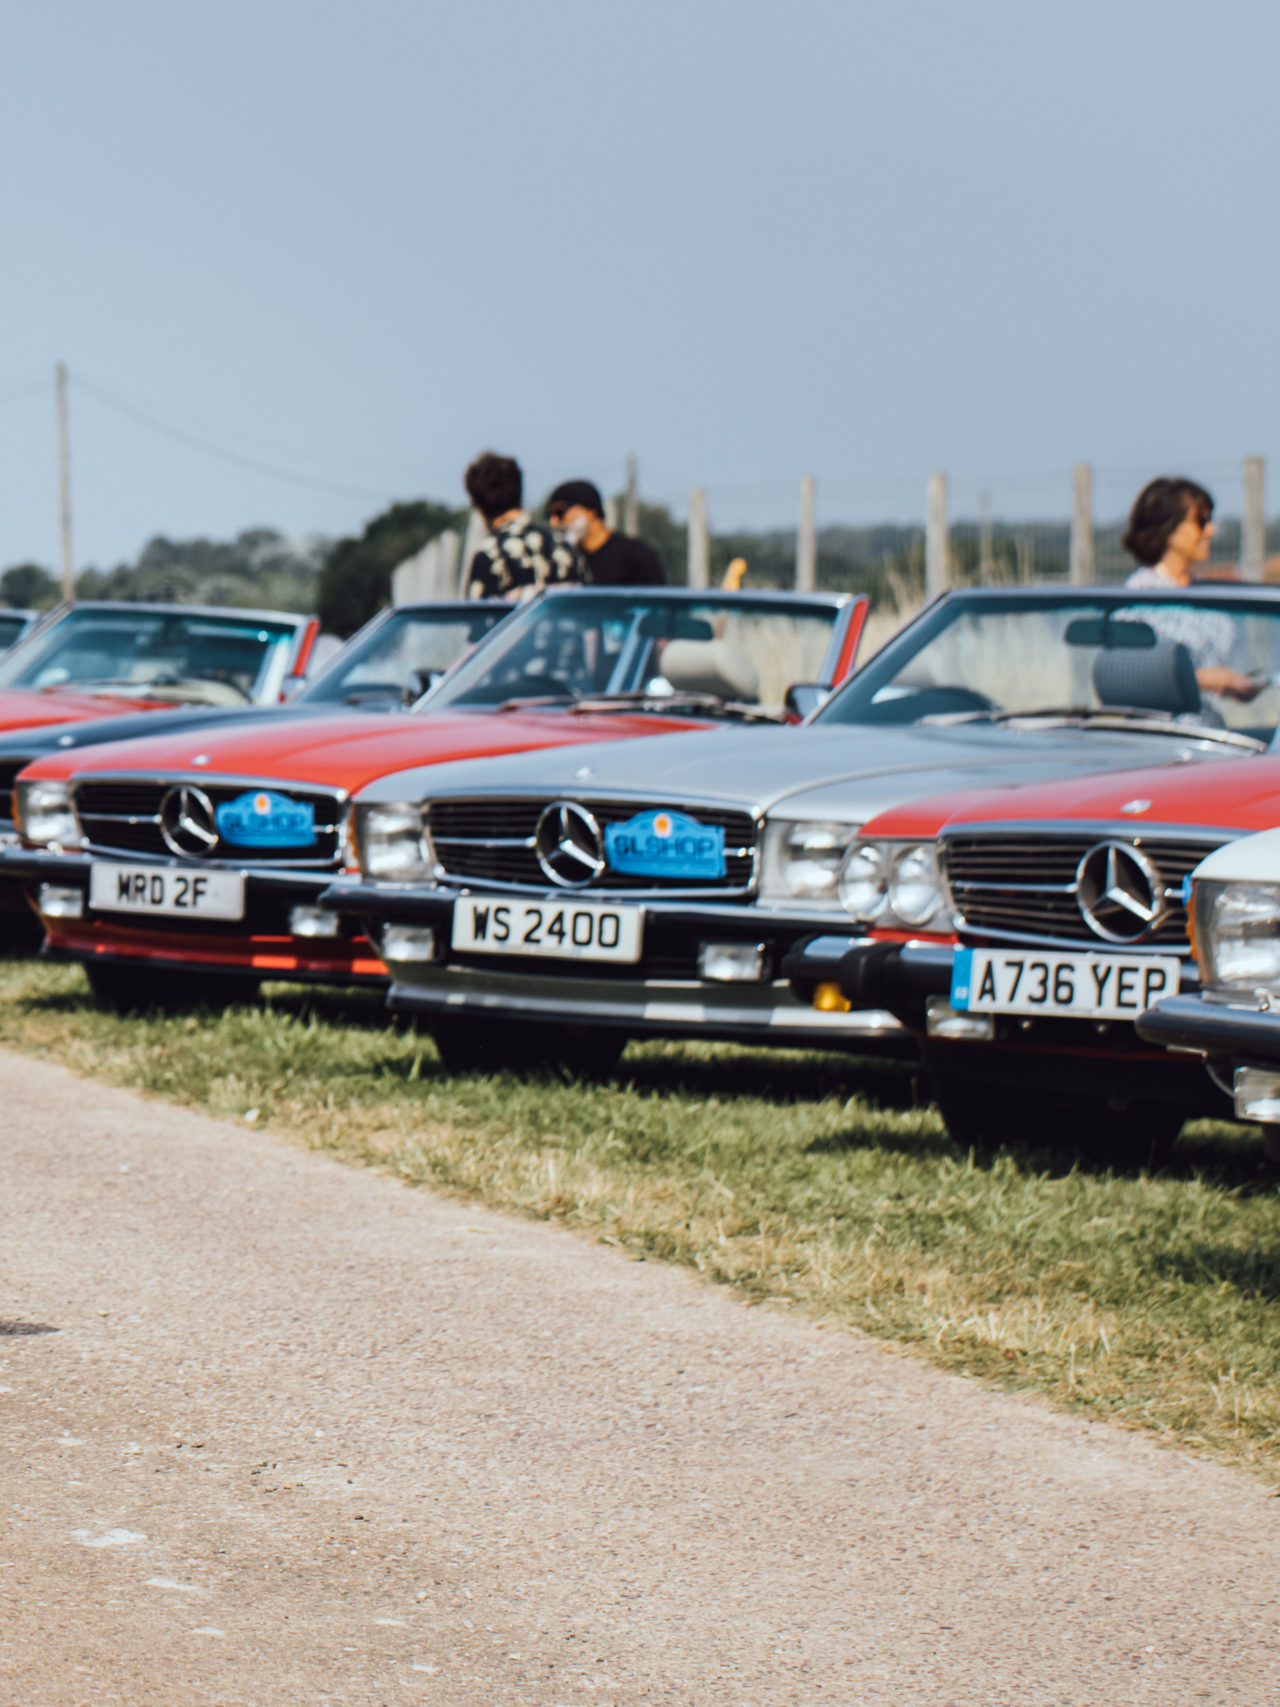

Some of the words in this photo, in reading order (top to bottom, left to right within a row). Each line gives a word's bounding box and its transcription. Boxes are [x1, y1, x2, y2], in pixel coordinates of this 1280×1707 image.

[118, 873, 165, 905] WRD
[174, 877, 208, 908] 2F
[472, 905, 512, 942] WS
[523, 908, 621, 948] 2400
[978, 960, 1075, 1004] A736
[1091, 964, 1167, 1009] YEP
